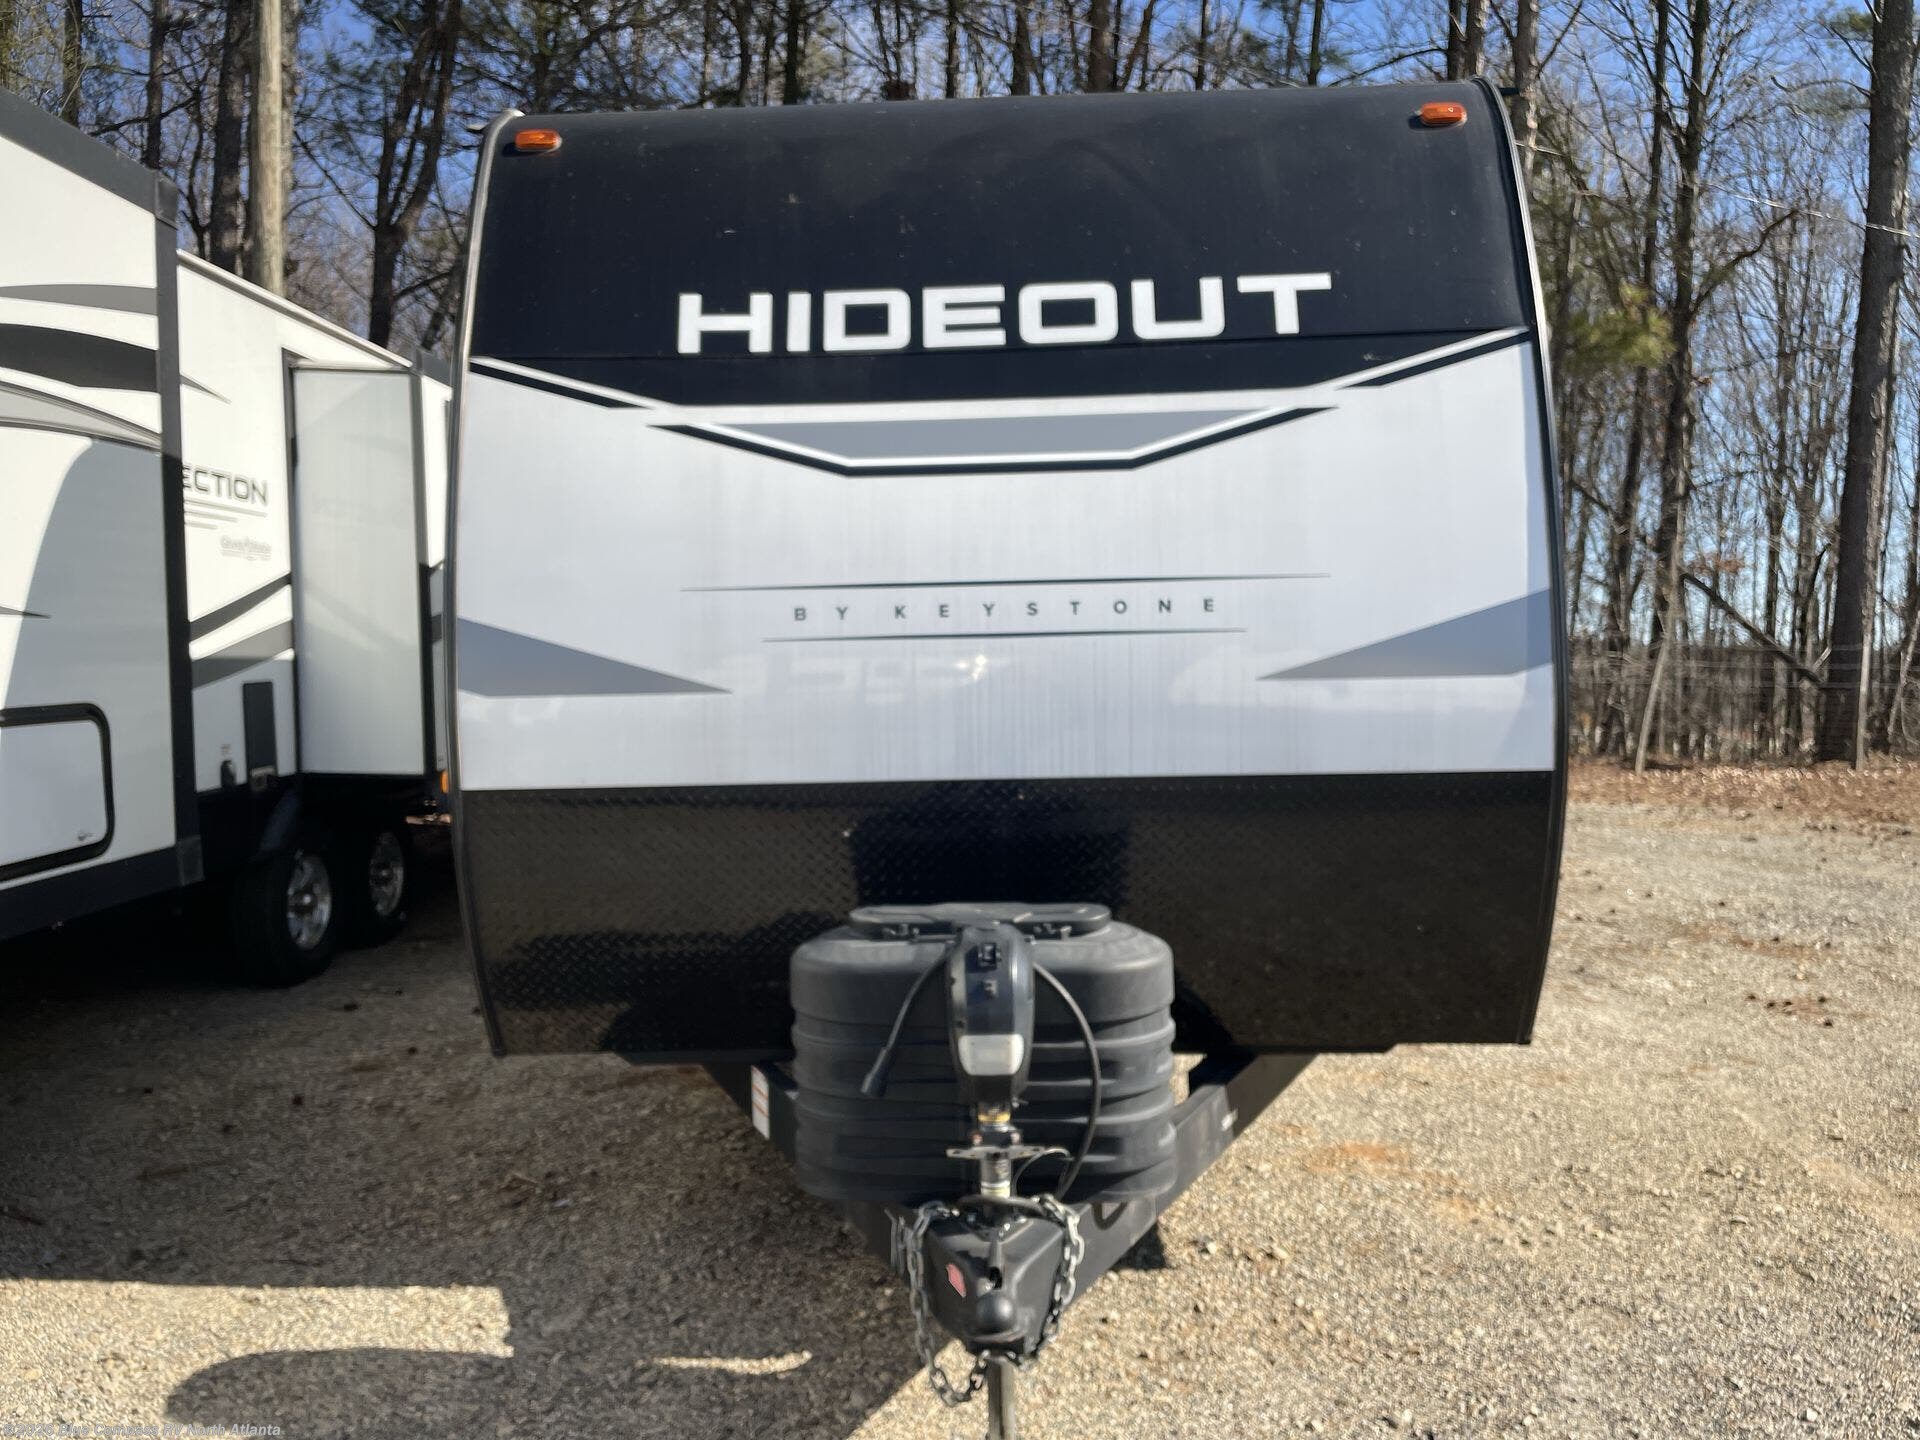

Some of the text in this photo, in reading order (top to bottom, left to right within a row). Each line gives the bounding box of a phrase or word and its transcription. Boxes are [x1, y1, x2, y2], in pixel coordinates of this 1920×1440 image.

[677, 272, 1332, 354] HIDEOUT
[793, 597, 1216, 622] BY KEYSTONE
